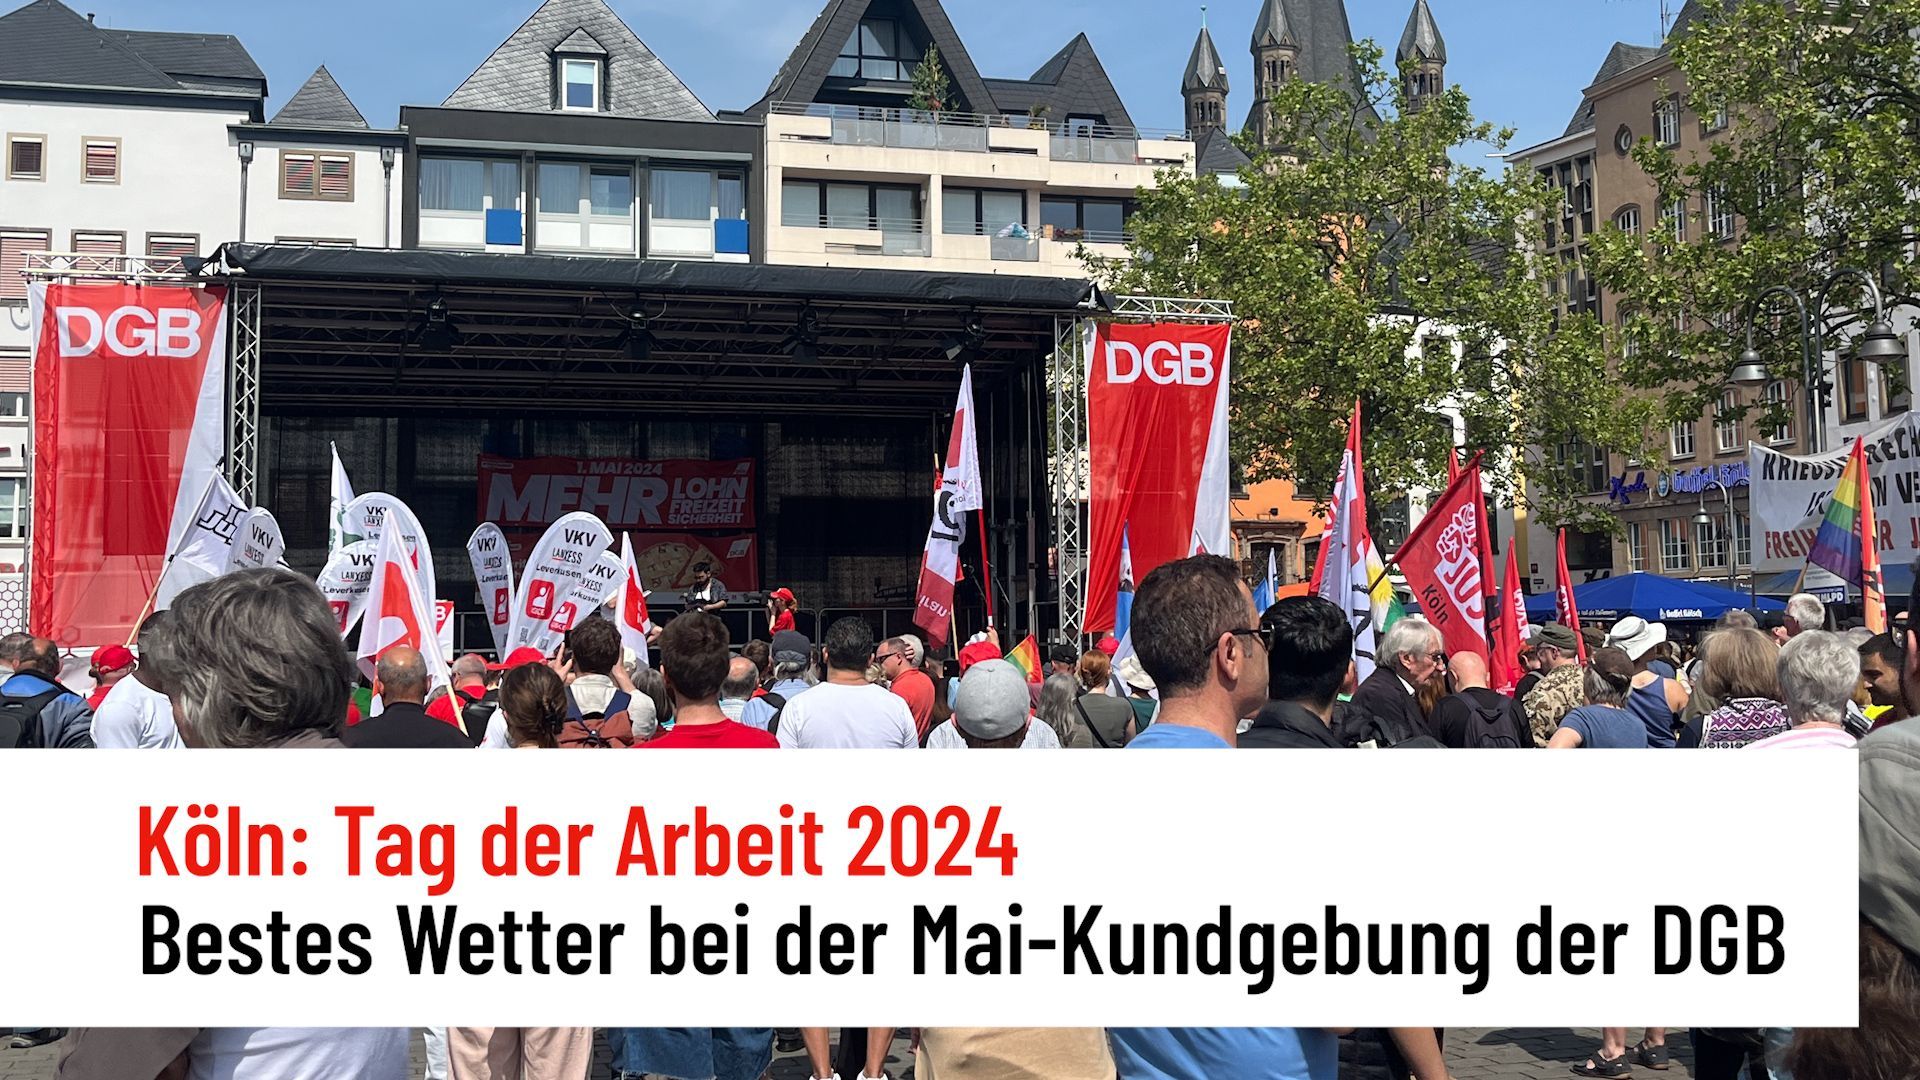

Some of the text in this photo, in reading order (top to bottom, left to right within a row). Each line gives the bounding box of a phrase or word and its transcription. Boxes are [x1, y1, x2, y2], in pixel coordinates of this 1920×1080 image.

[56, 305, 202, 358] DGB
[1105, 340, 1215, 386] DGB
[576, 463, 663, 475] 1. MAI 2024
[486, 472, 669, 525] MEHR
[672, 477, 749, 500] LOHN
[366, 506, 387, 516] VK
[669, 498, 746, 515] FREIZEIT
[667, 512, 744, 525] SICHERHEIT
[252, 523, 274, 550] VKV
[564, 528, 597, 547] VKV
[552, 547, 583, 565] LANXESS
[1421, 583, 1449, 625] Köln
